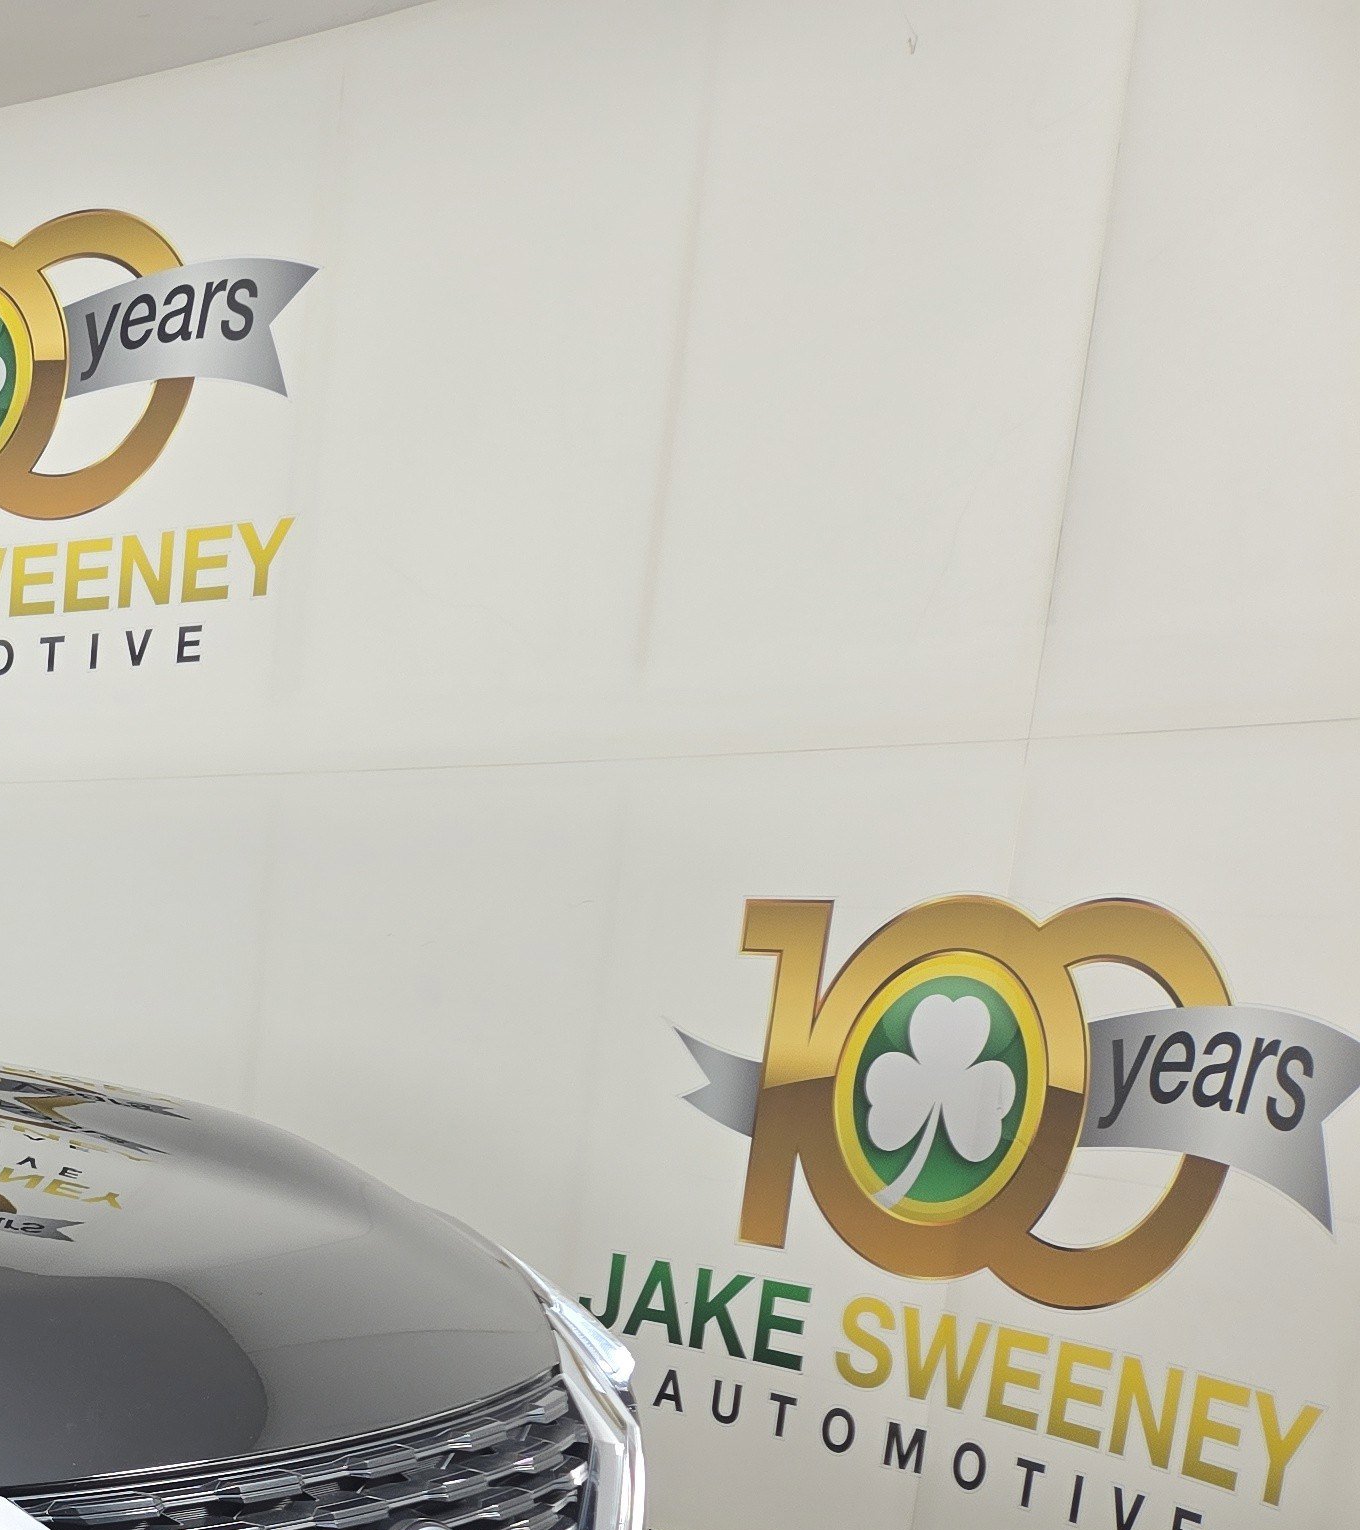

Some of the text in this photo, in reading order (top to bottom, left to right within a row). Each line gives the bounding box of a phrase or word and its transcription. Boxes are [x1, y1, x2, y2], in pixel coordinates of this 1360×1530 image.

[80, 277, 259, 382] years
[1097, 1028, 1315, 1132] years
[578, 1252, 1323, 1509] JAKE SWEENEY
